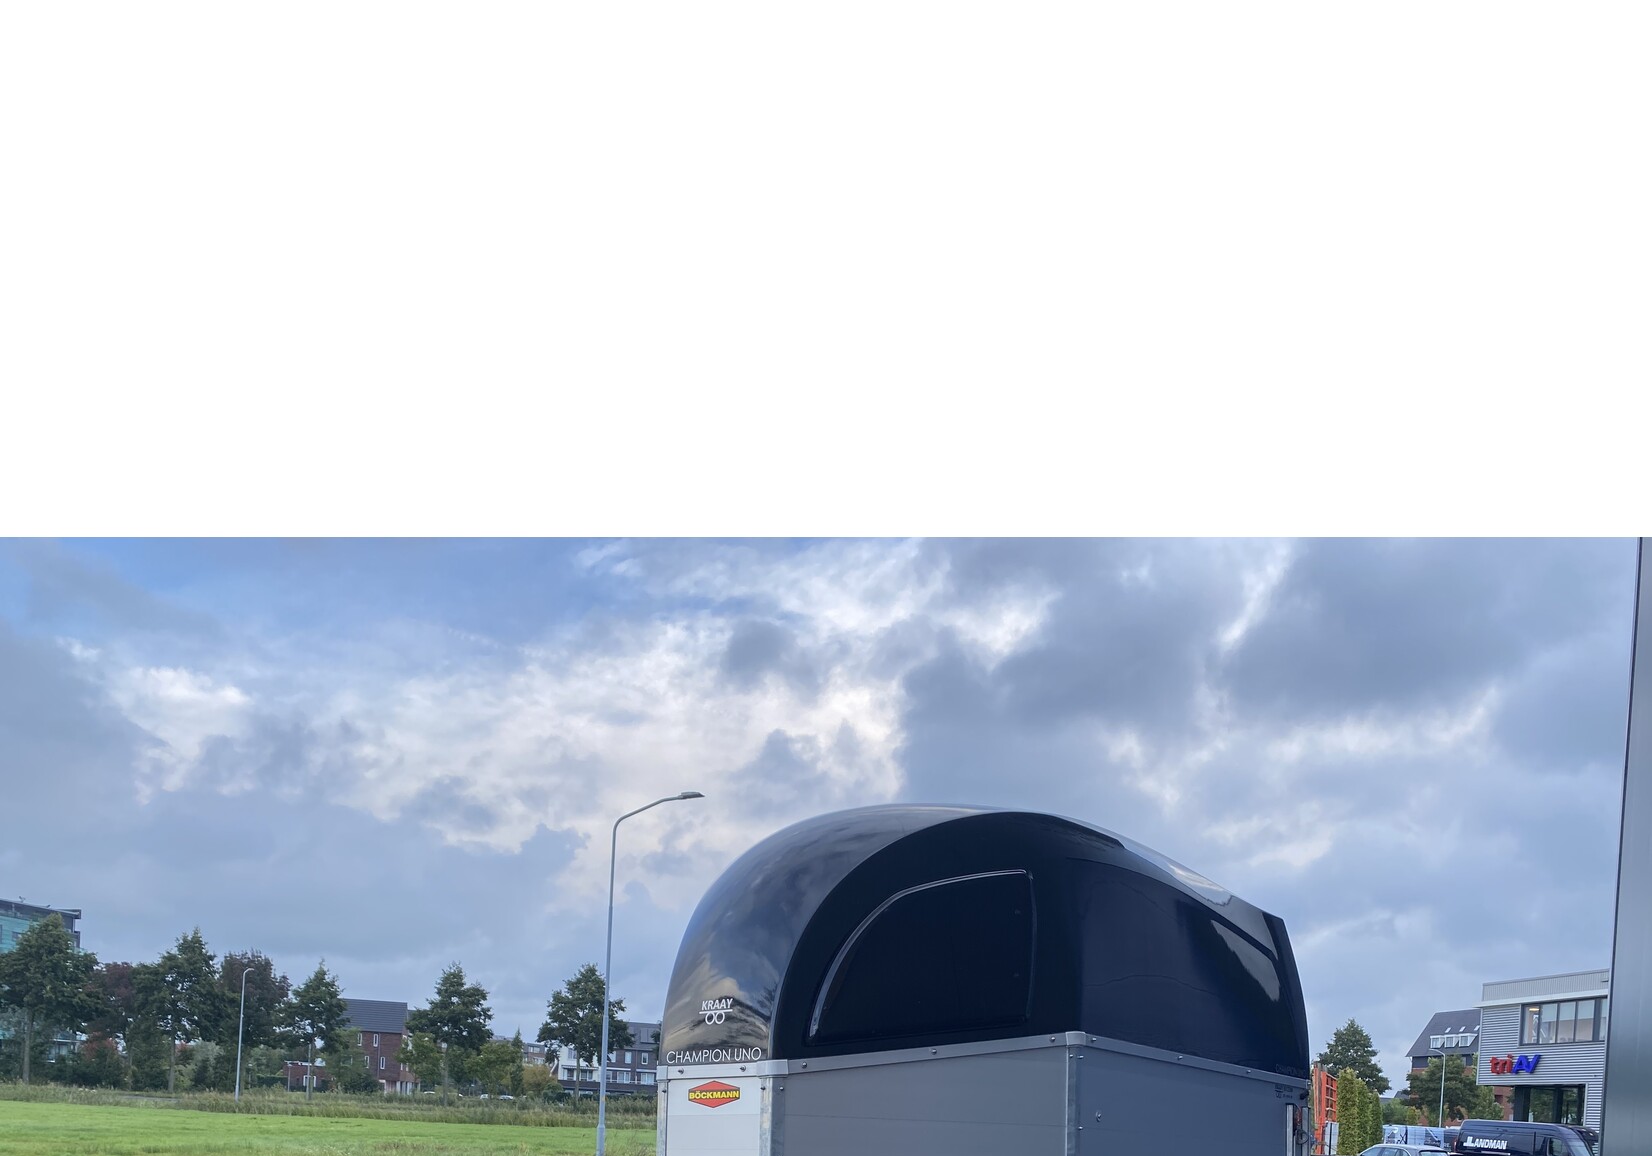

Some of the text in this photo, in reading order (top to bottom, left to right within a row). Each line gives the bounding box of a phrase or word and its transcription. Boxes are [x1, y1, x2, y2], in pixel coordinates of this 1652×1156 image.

[701, 998, 733, 1010] KRAAY
[666, 1047, 762, 1064] CHAMPION UNO
[689, 1090, 739, 1099] BÖCKMANN
